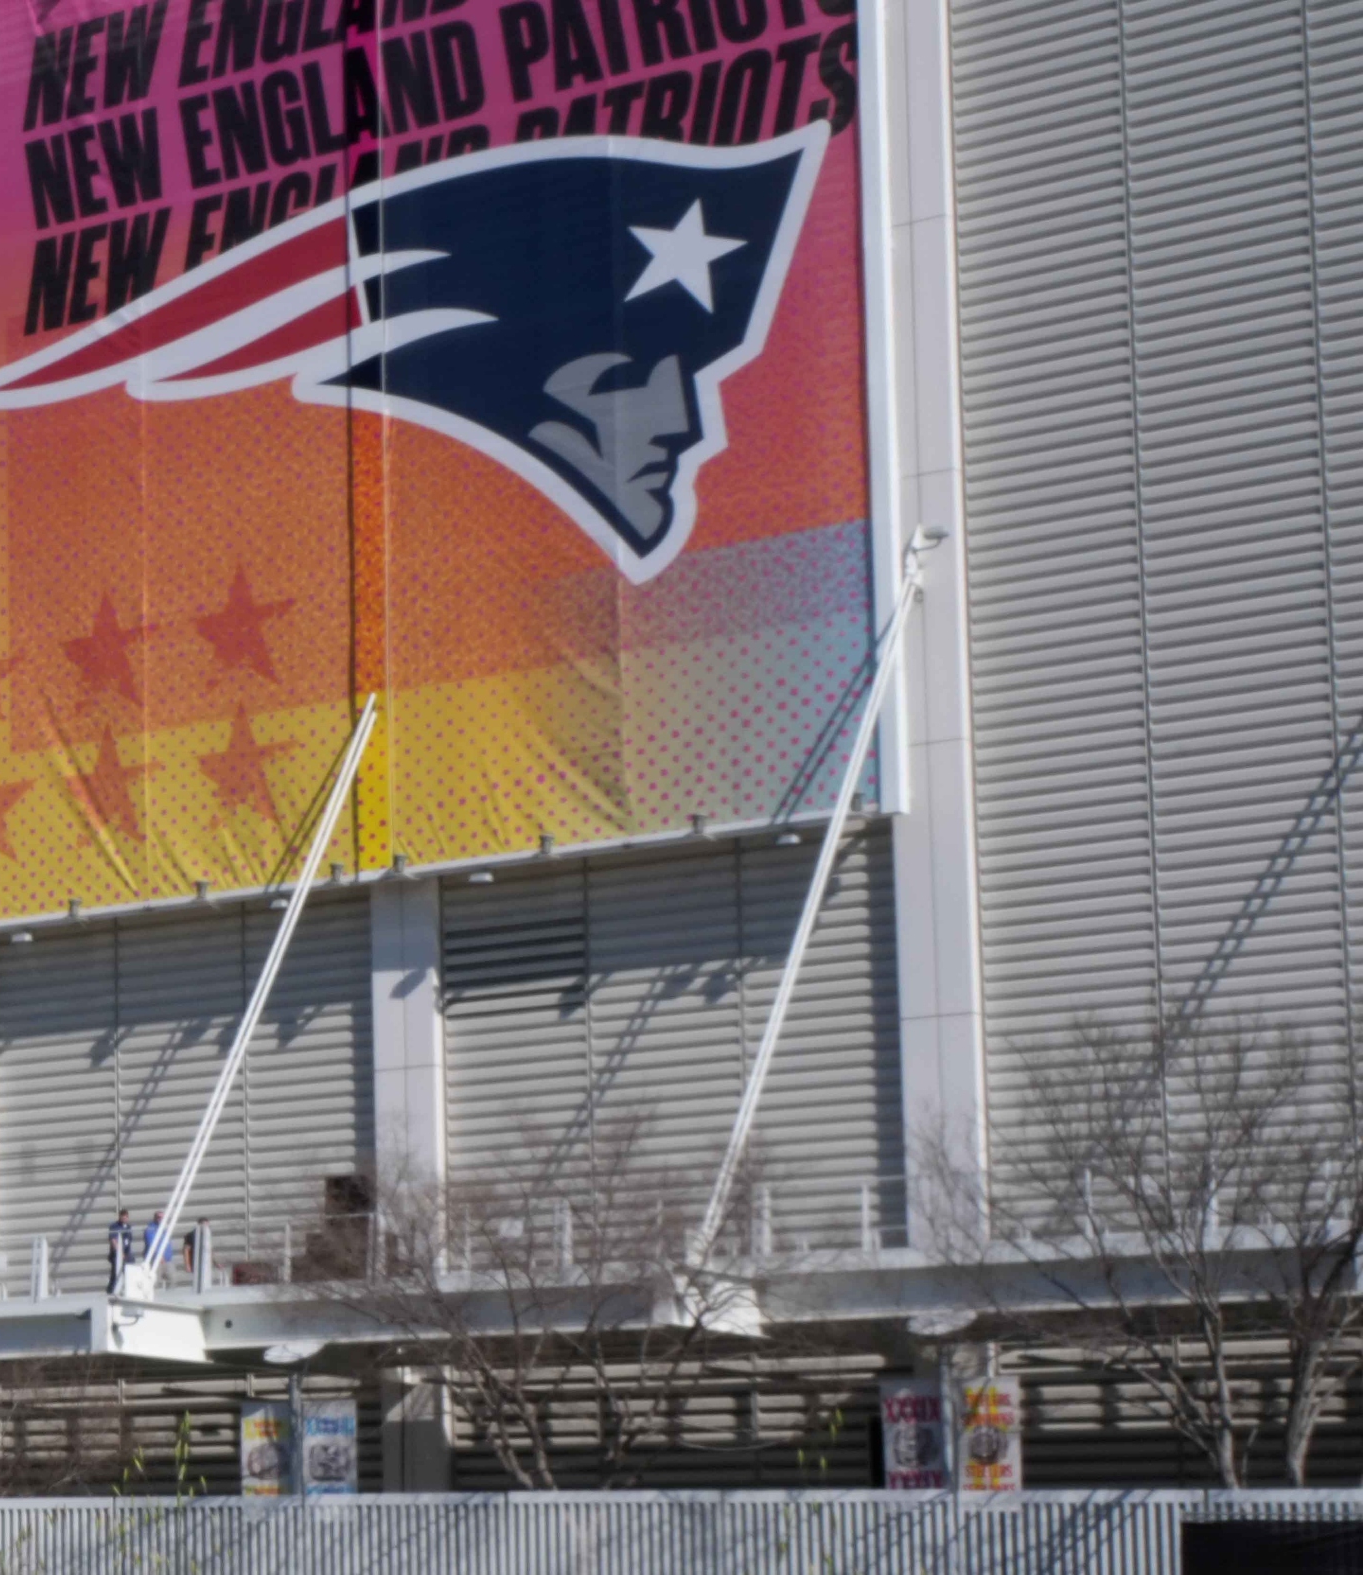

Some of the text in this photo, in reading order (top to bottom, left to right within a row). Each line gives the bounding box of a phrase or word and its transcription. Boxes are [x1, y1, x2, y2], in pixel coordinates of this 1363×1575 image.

[22, 0, 167, 132] NEW
[24, 107, 162, 231] NEW
[178, 18, 486, 190] ENGLAND
[23, 207, 172, 337] NEW
